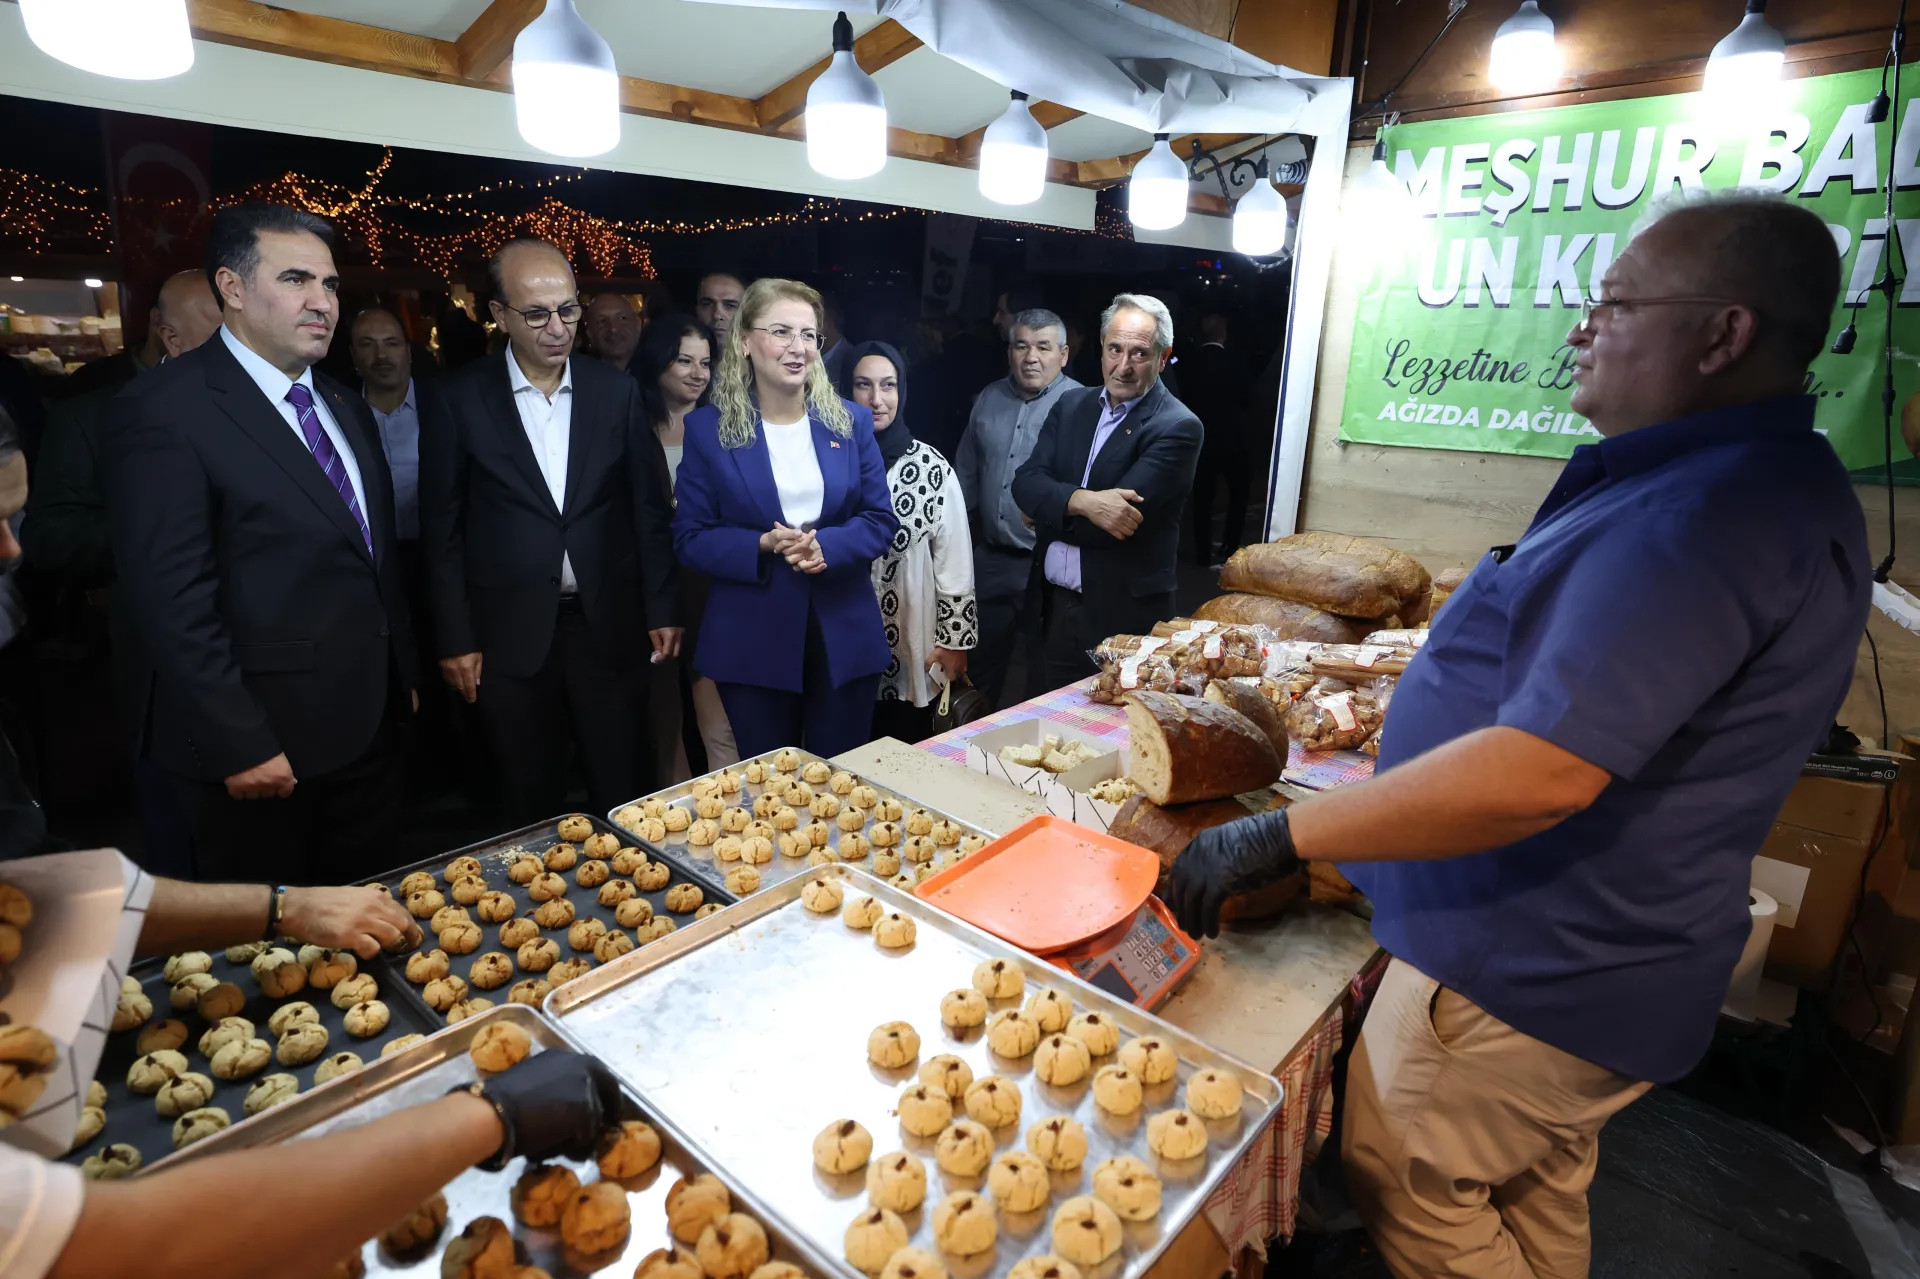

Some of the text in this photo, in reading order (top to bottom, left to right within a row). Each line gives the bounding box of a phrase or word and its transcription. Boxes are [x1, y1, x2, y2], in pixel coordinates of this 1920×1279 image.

[1391, 122, 1718, 228] MEŞHUR
[1417, 236, 1520, 309] UN
[1382, 338, 1531, 396] Lezzetine
[1377, 396, 1606, 438] AĞIZDA DAĞILA
